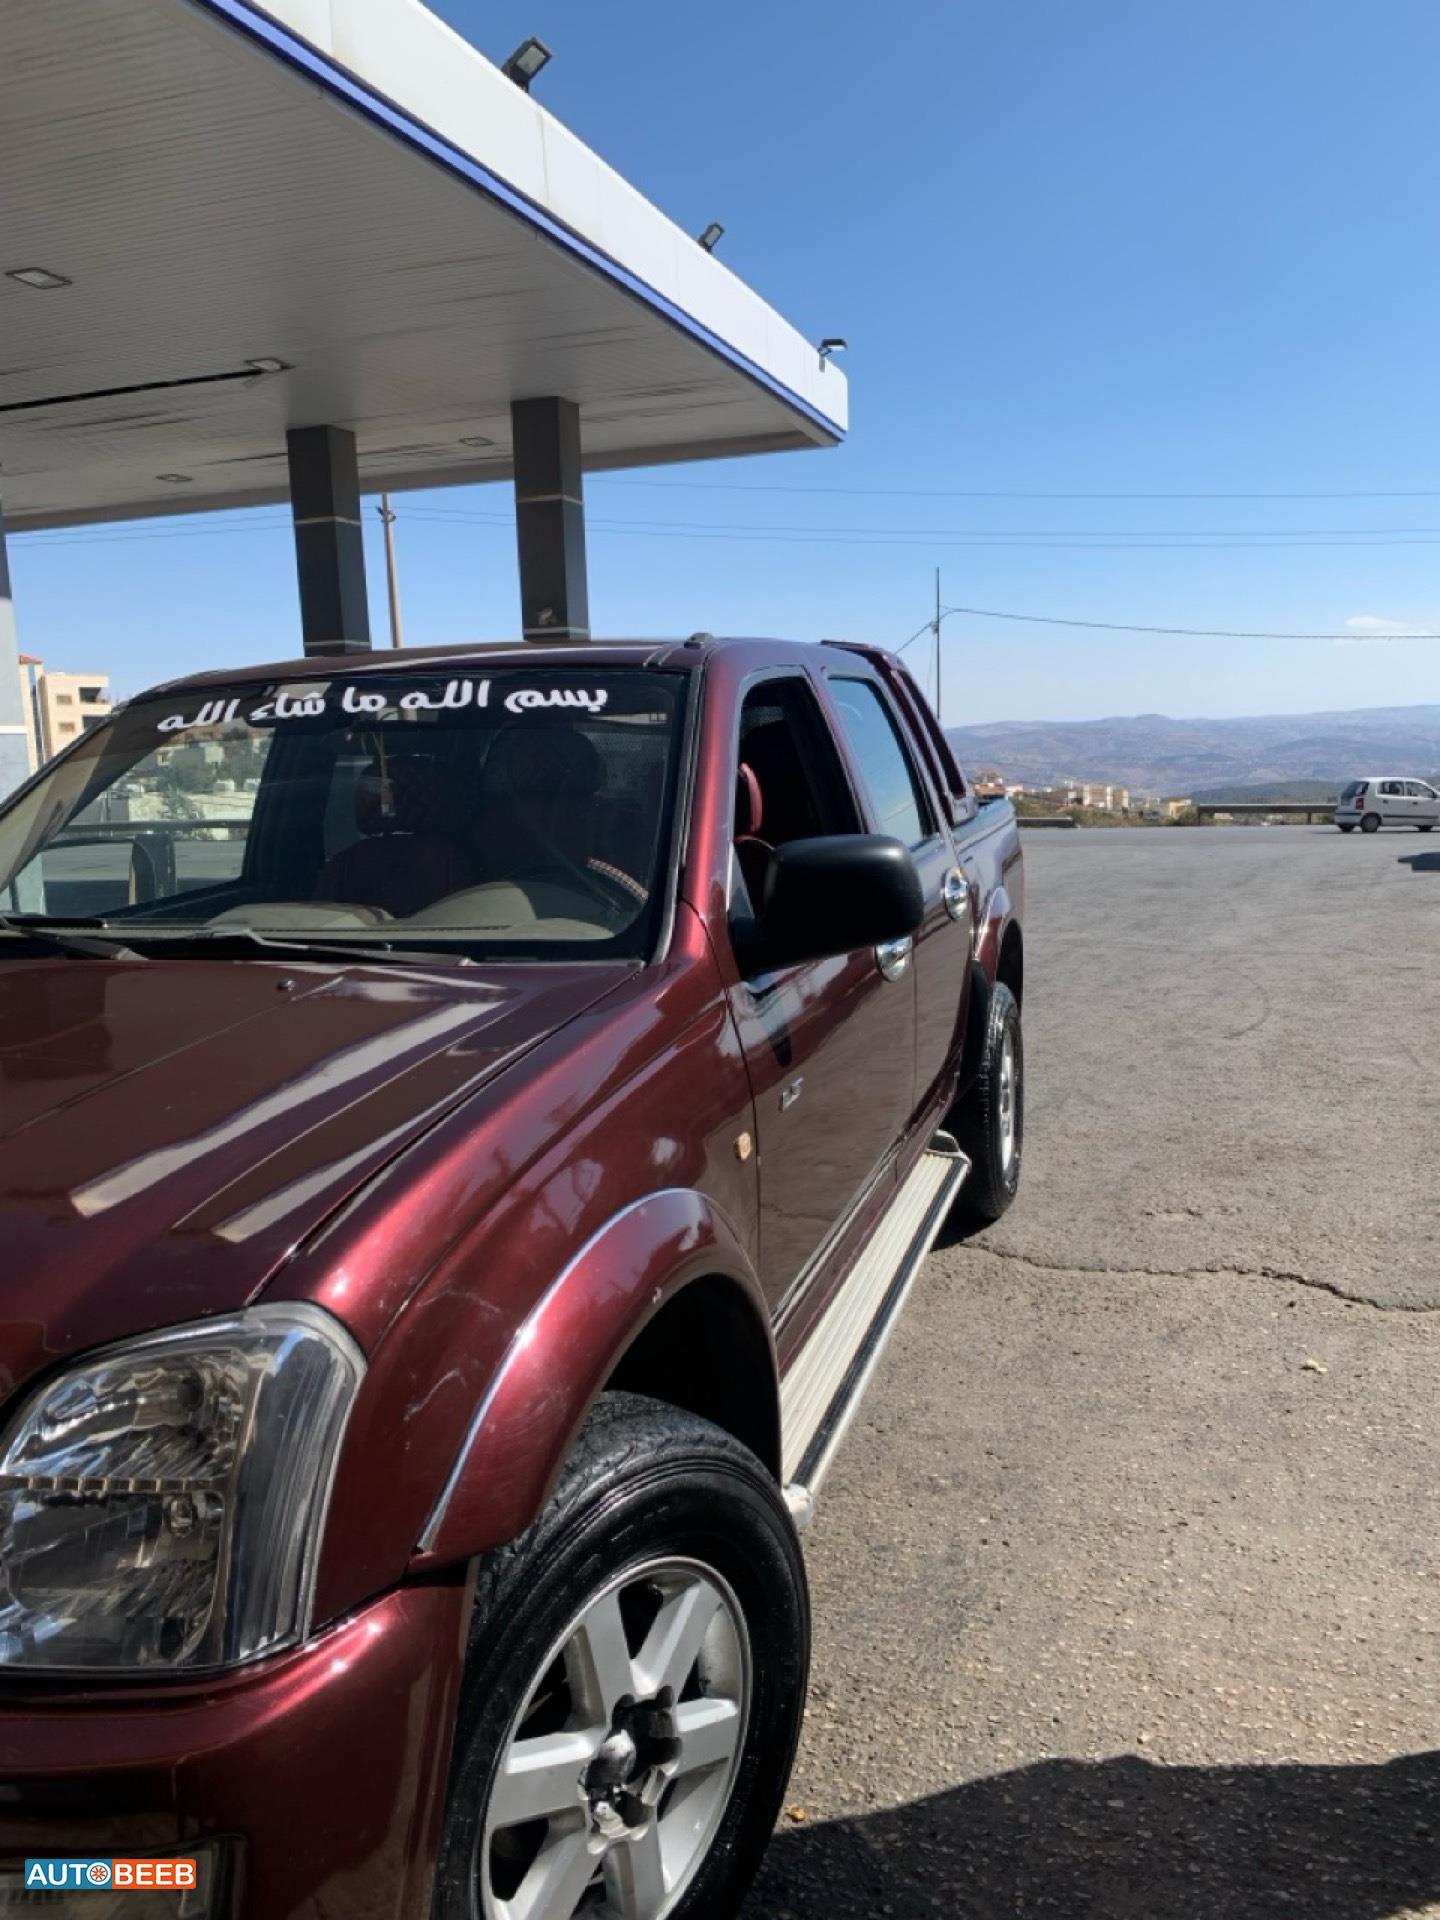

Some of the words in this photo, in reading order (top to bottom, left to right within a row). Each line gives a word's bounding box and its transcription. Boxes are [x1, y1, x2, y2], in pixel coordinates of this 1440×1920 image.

[249, 692, 326, 721] شاء
[341, 686, 386, 713] ما
[399, 679, 491, 709] الله
[504, 689, 608, 713] بسم
[157, 698, 241, 732] الله
